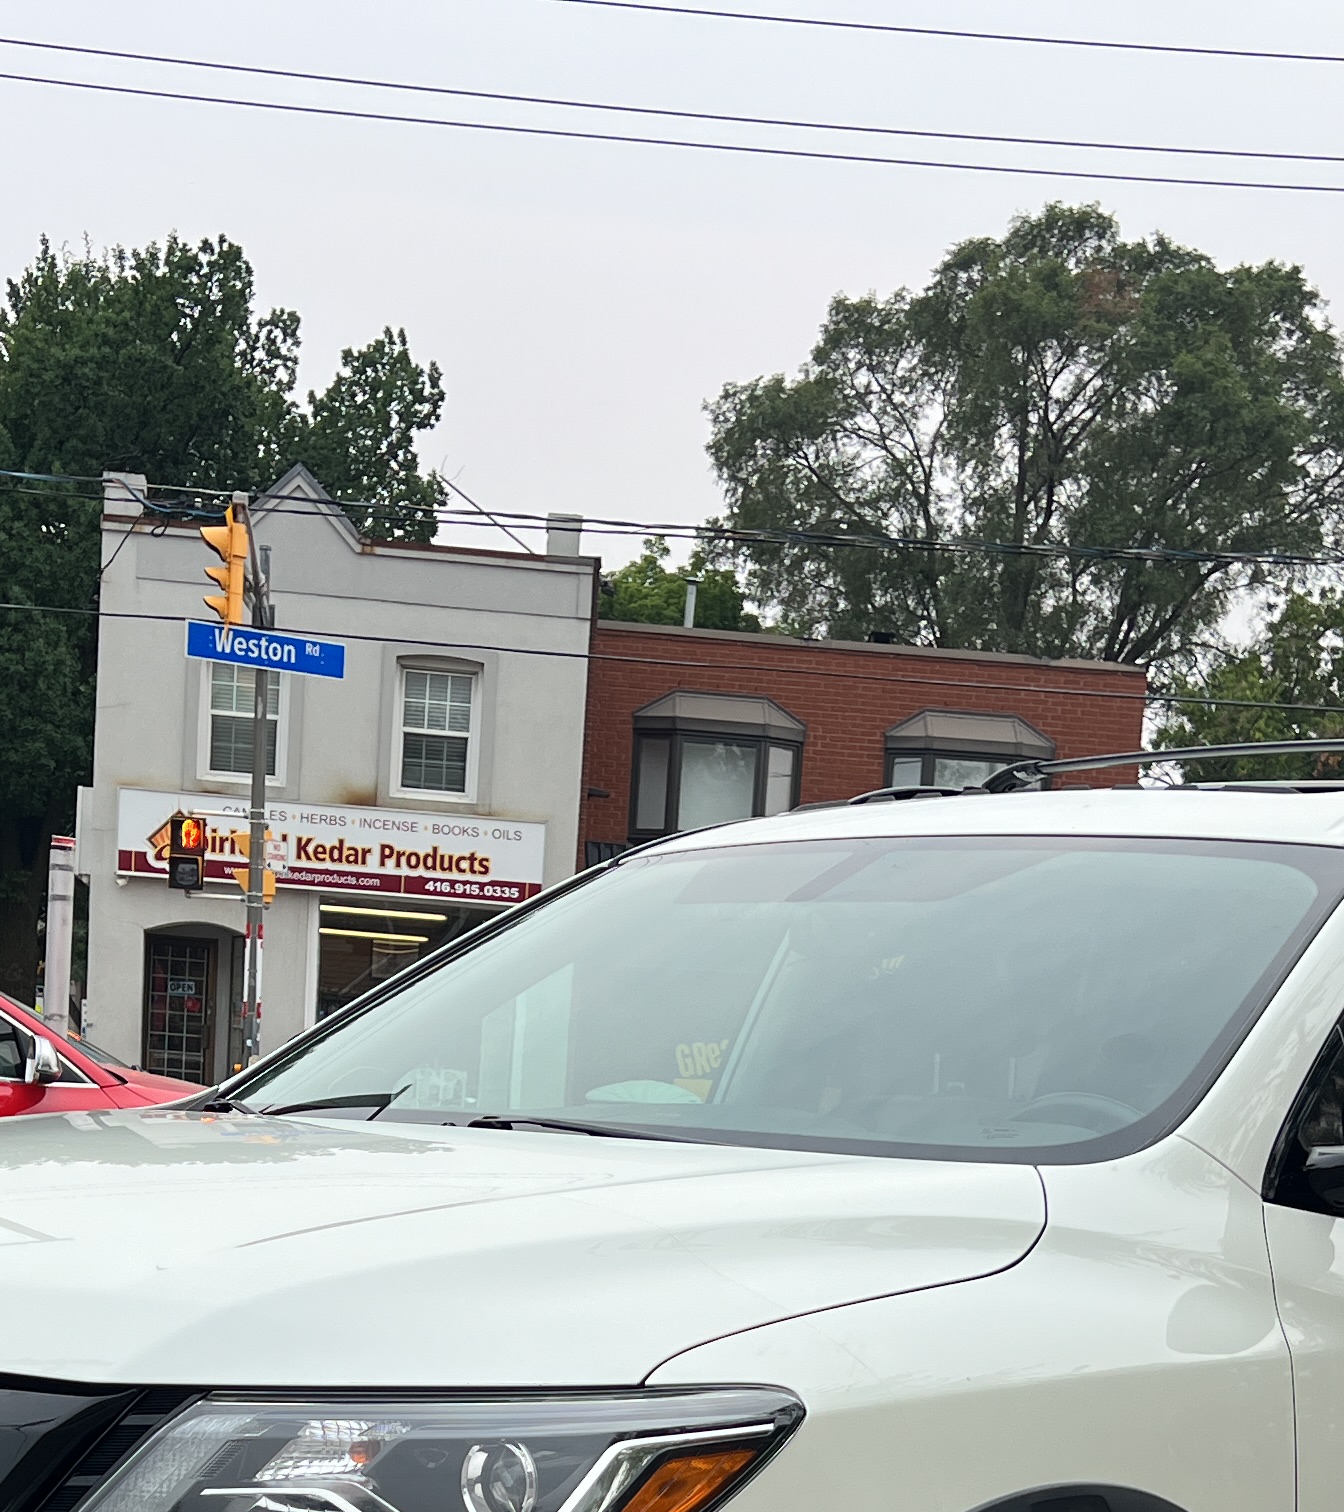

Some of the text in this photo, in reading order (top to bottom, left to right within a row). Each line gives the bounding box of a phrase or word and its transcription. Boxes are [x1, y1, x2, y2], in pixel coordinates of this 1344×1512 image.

[214, 628, 320, 664] Weston Rd
[299, 811, 347, 827] HERBS
[358, 817, 420, 834] INCENSE
[431, 823, 481, 839] BOOKS
[491, 828, 523, 842] OILS
[296, 836, 372, 869] Kedar
[379, 843, 491, 876] Products
[424, 880, 520, 900] 416.915.0335
[169, 982, 194, 993] OPEN
